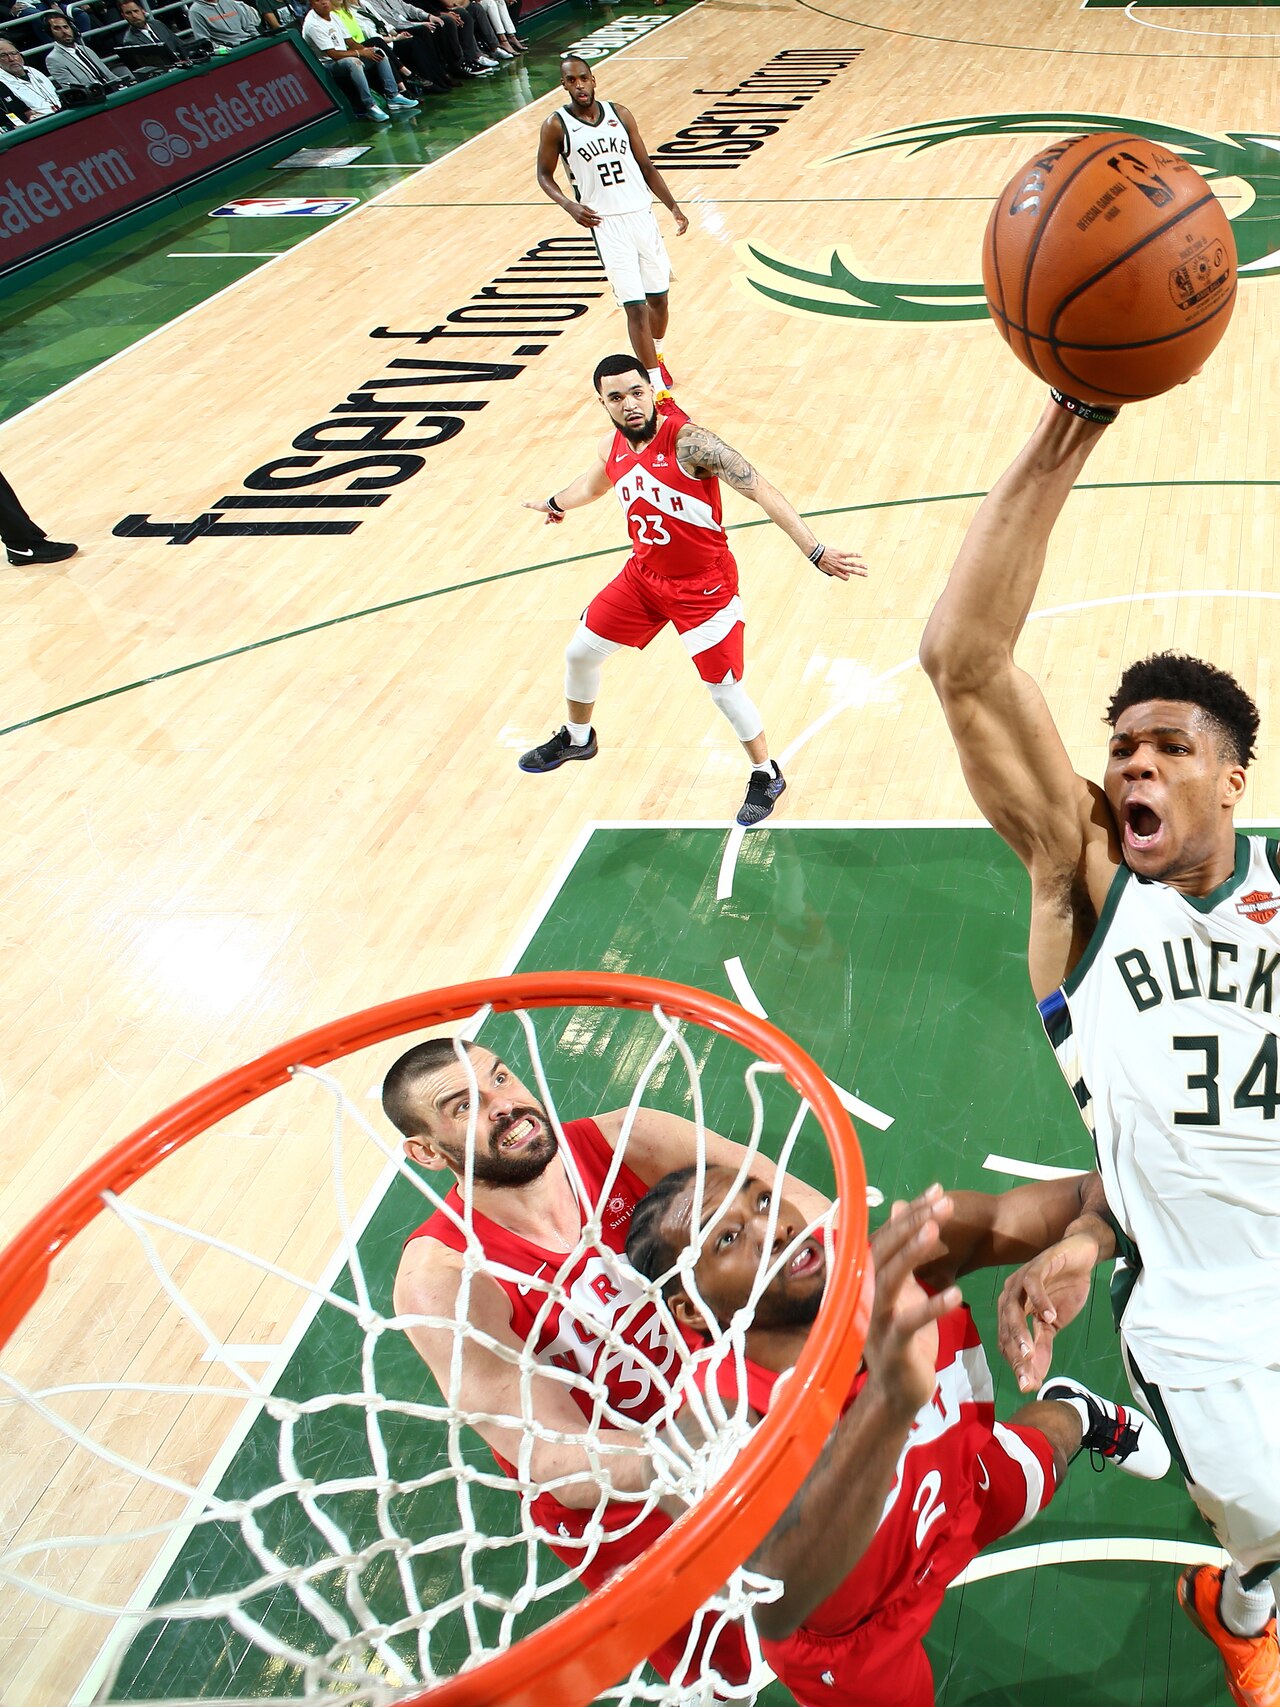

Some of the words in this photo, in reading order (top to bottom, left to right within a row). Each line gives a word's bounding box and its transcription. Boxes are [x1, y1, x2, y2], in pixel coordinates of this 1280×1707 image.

[560, 15, 672, 60] @BUCKS
[577, 136, 627, 162] BUCKS
[0, 148, 136, 240] ateFarm
[597, 160, 626, 187] 22
[1076, 205, 1102, 232] OFFICIAL
[1095, 191, 1116, 211] GAME
[1110, 182, 1128, 199] BALL
[112, 237, 608, 545] fiserv.forum
[630, 514, 671, 545] 23
[1245, 893, 1269, 903] MOTOR
[610, 1215, 627, 1230] Sun
[603, 1311, 675, 1408] 33
[912, 1469, 947, 1550] 2
